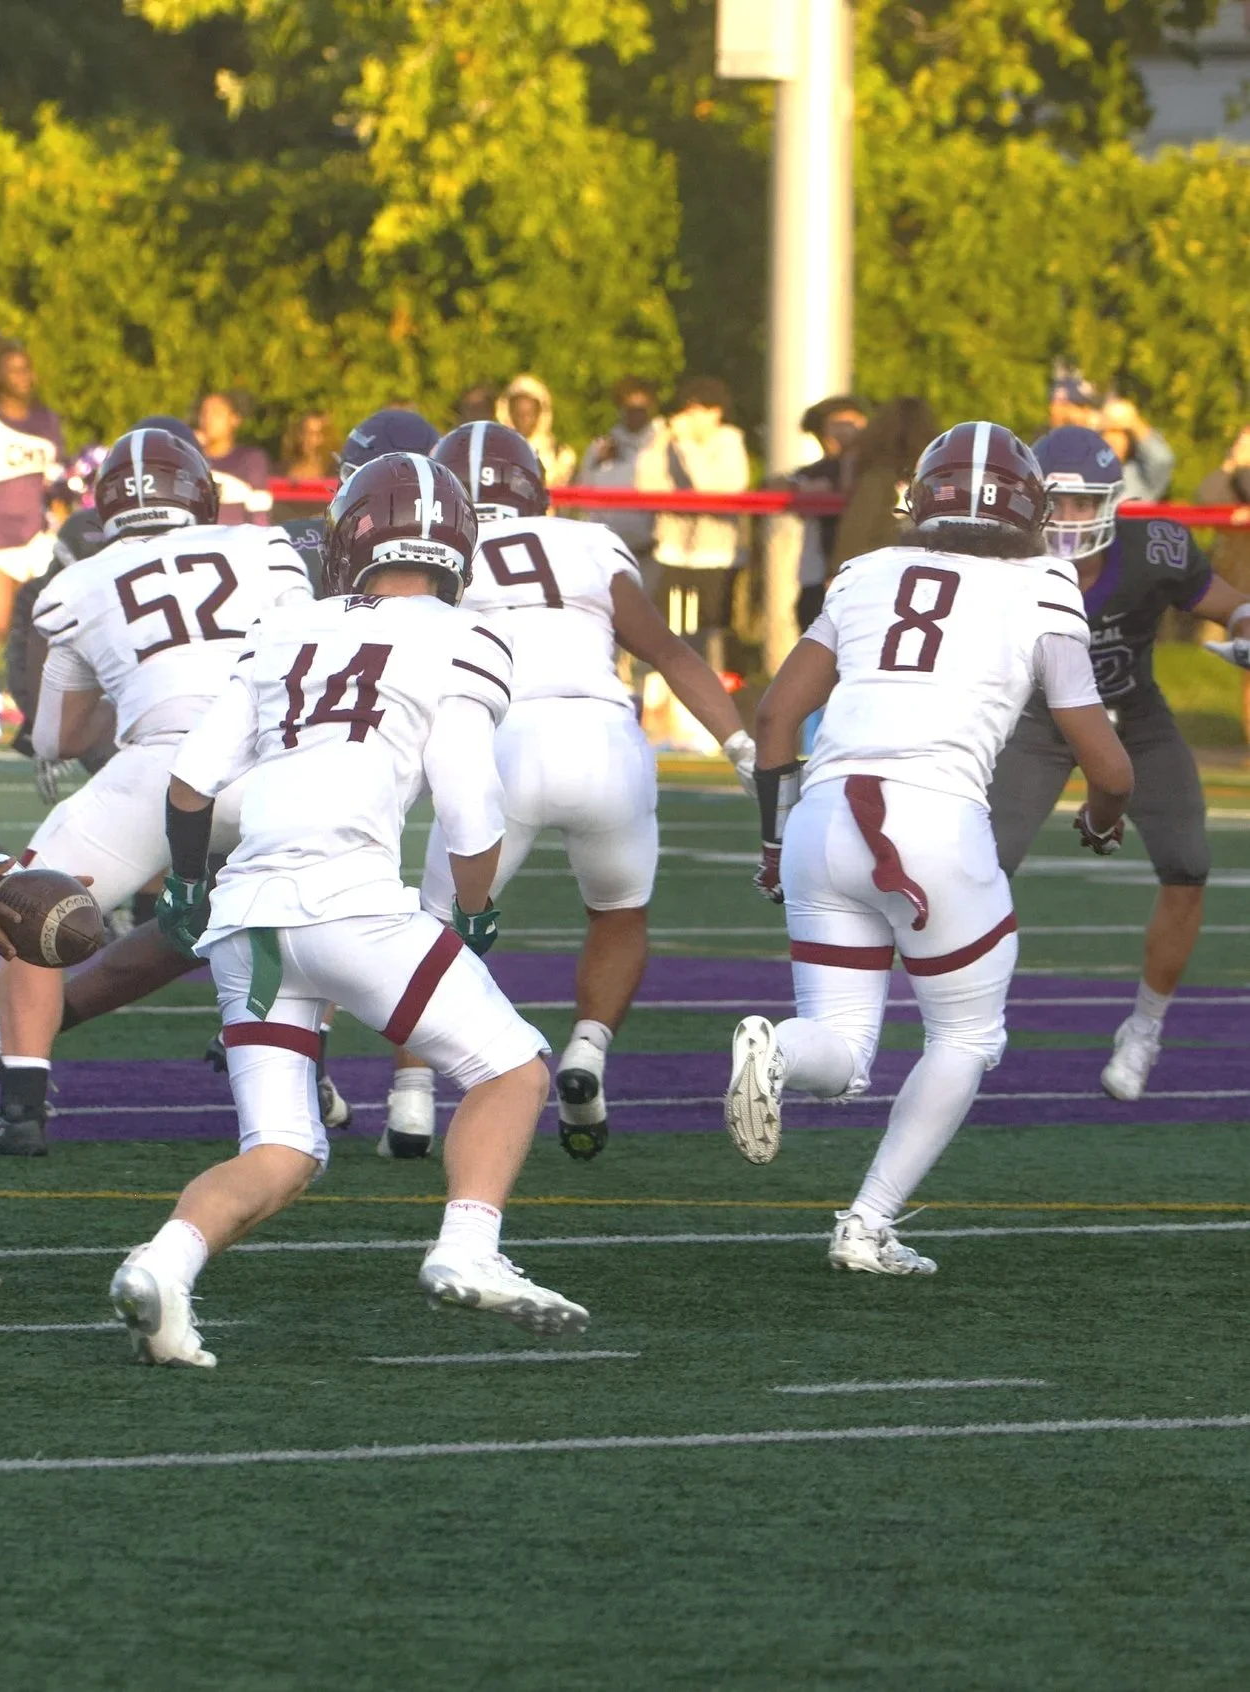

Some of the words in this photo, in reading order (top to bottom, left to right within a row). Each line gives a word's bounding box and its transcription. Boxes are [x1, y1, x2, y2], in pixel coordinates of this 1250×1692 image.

[124, 474, 156, 497] 52
[481, 467, 495, 486] 9
[983, 484, 997, 505] 8
[414, 499, 444, 523] 14
[1146, 521, 1188, 569] 22
[482, 532, 565, 610] 9
[115, 552, 247, 664] 52
[877, 565, 961, 672] 8
[279, 643, 393, 749] 14
